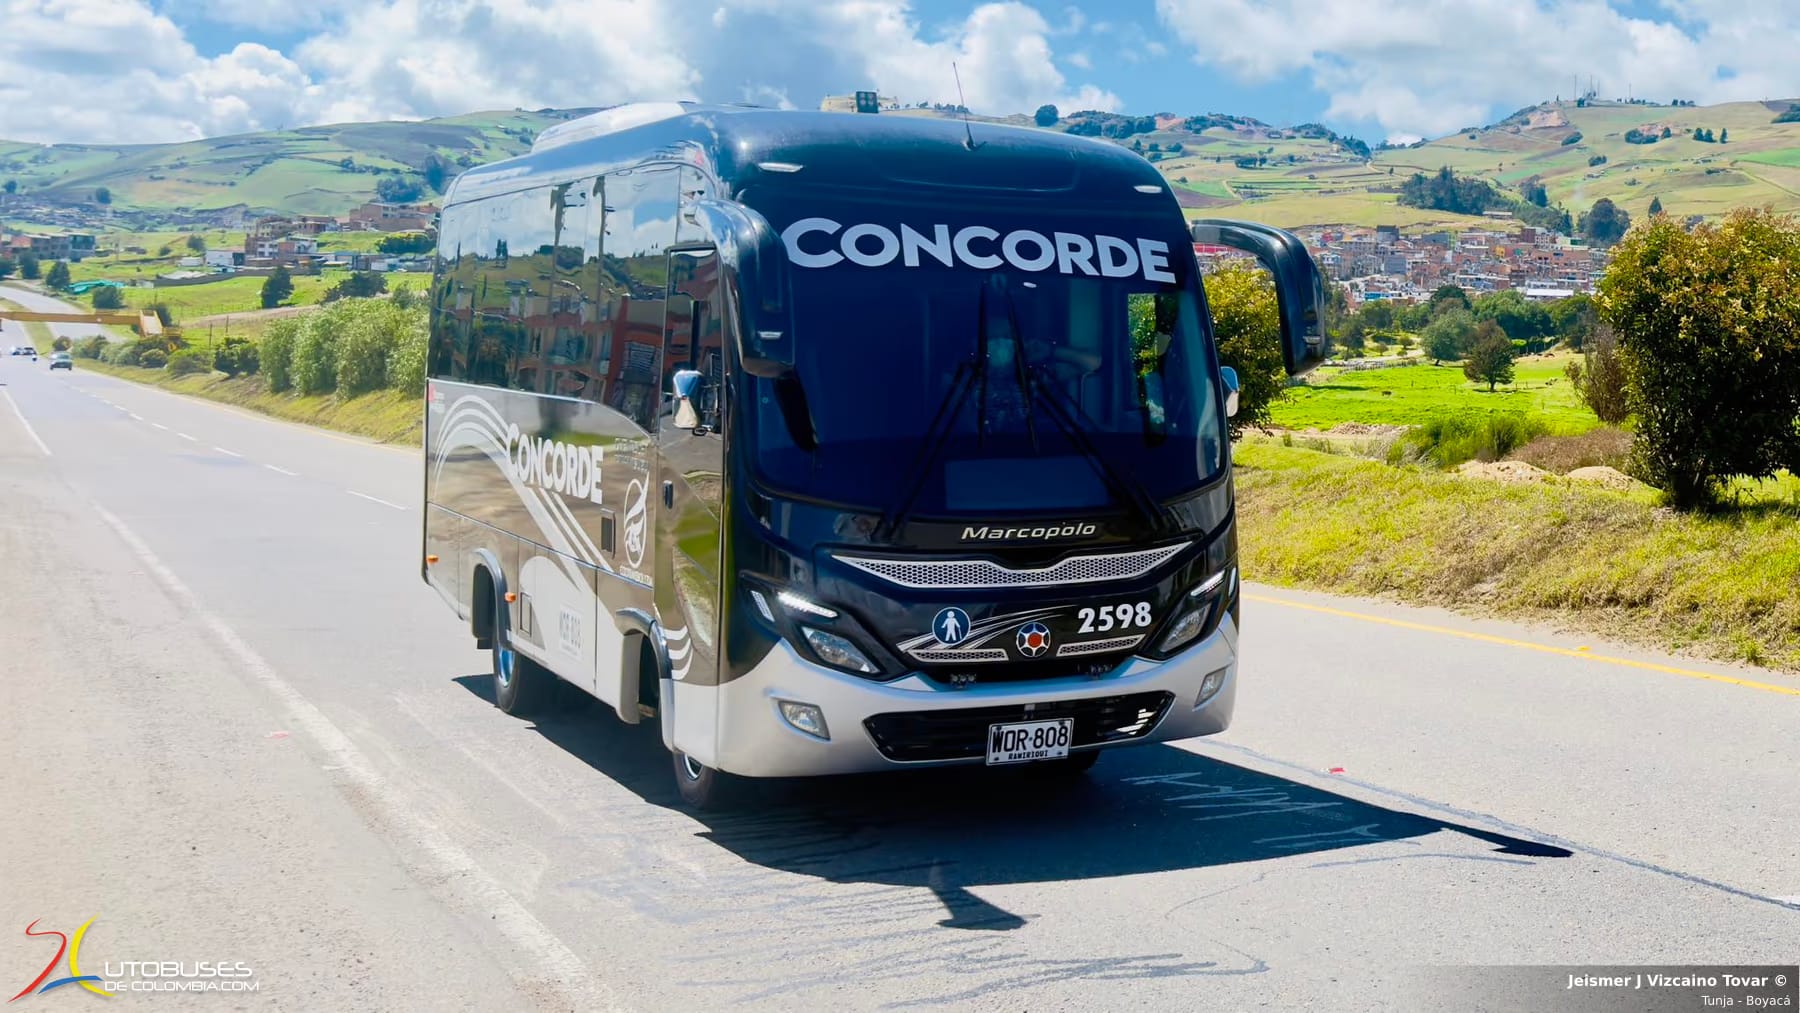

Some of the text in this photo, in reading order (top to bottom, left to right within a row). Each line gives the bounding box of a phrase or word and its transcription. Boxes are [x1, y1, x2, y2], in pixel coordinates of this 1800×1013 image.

[781, 217, 1176, 283] CONCORDE
[507, 423, 604, 504] CONCORDE
[962, 522, 1096, 540] Marcopolo
[1078, 602, 1152, 633] 2598
